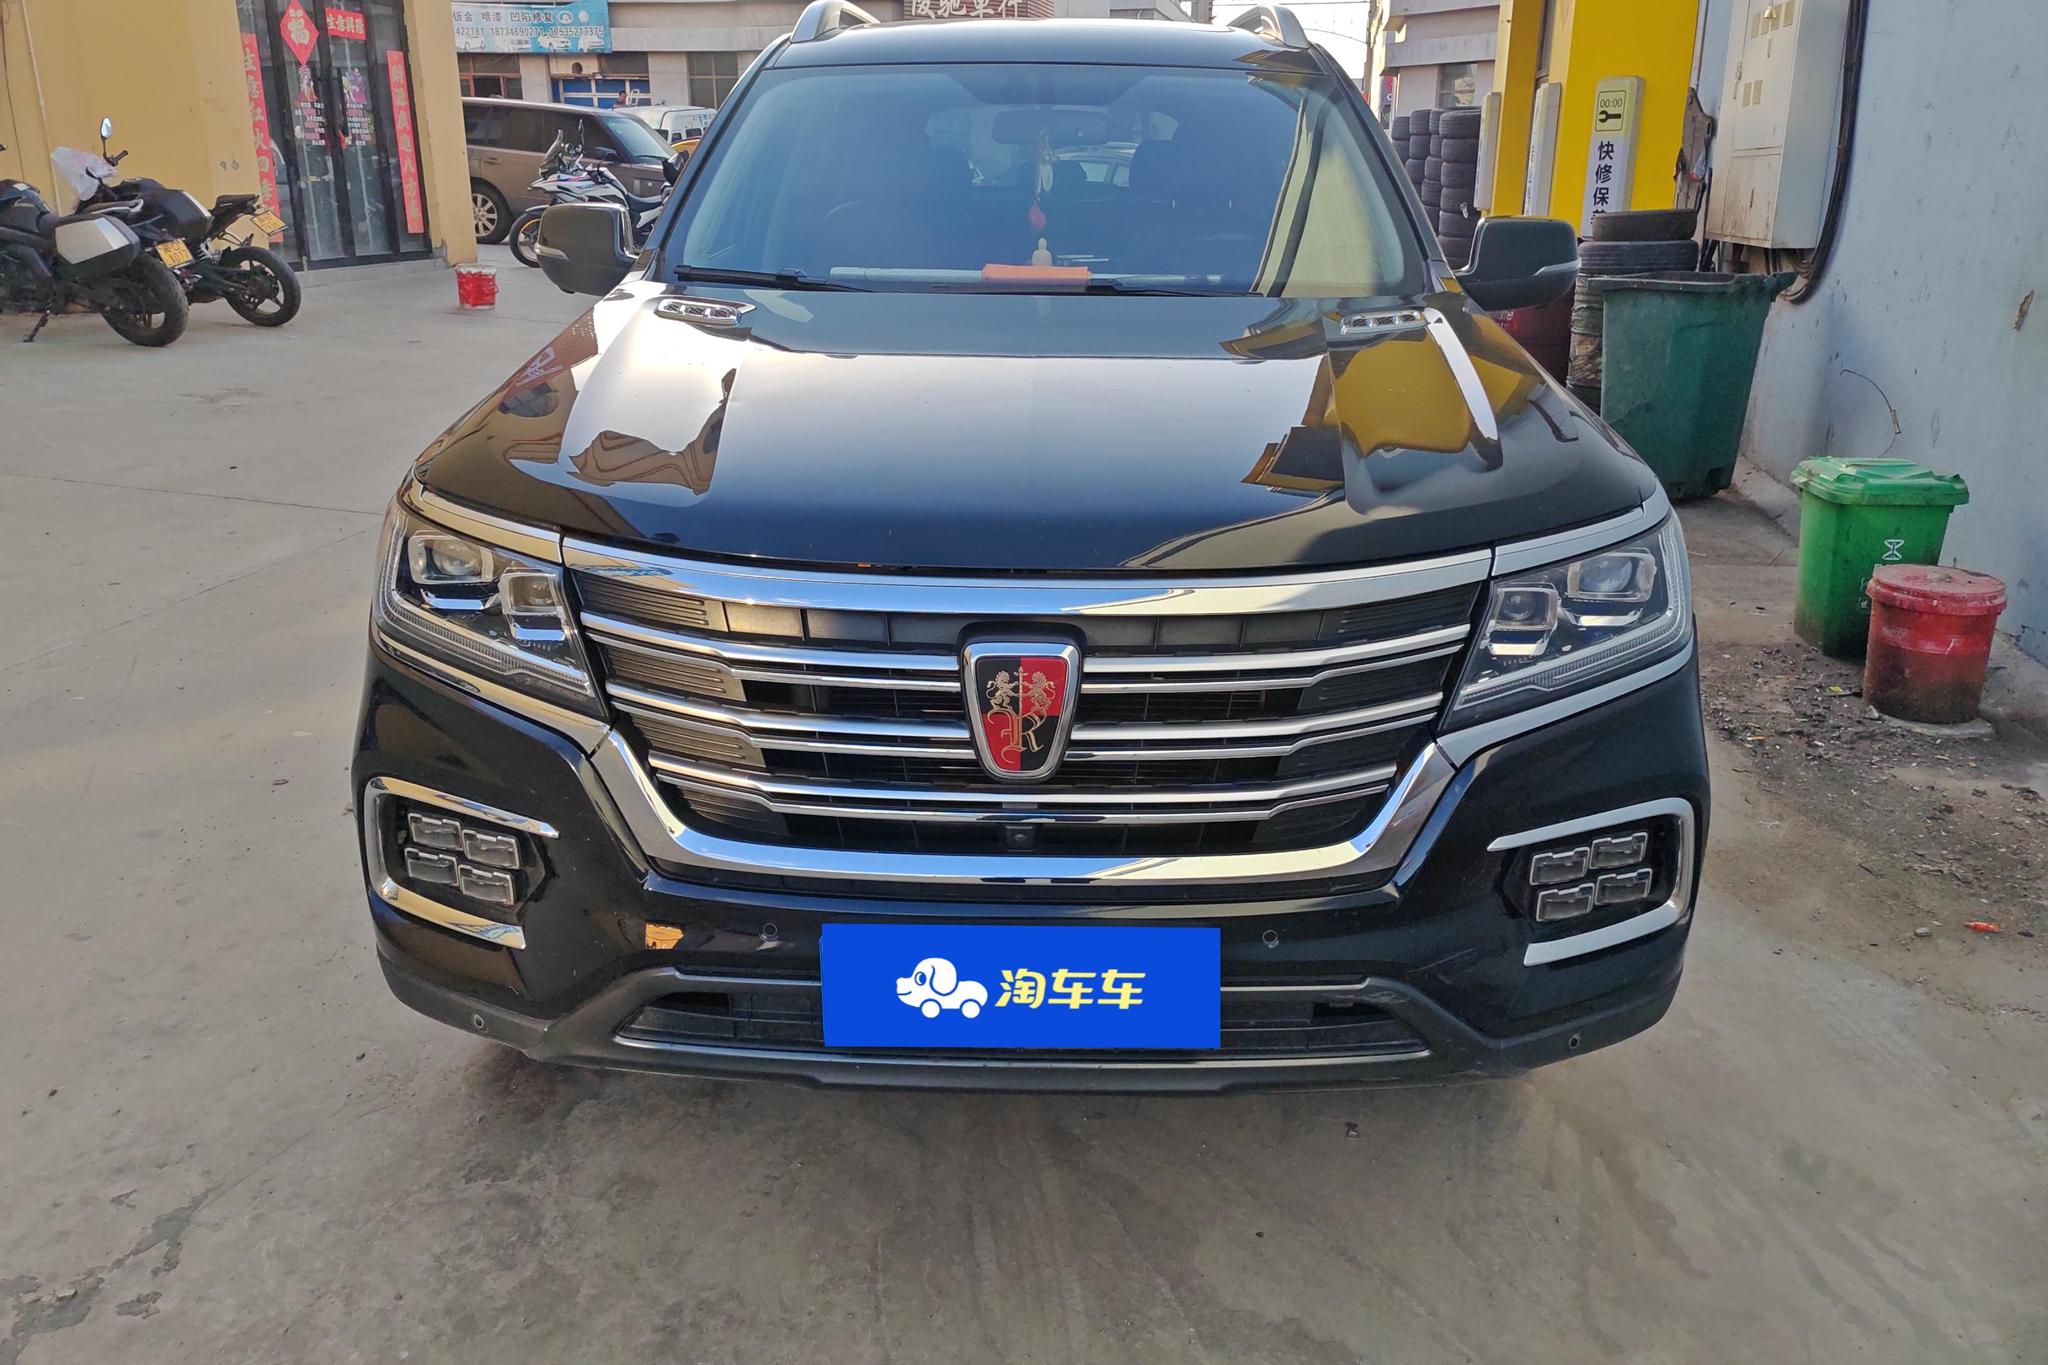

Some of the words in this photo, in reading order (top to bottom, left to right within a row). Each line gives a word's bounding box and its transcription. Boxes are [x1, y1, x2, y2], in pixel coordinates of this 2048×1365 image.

[1599, 98, 1623, 109] 00:00
[1590, 140, 1615, 224] 快修保
